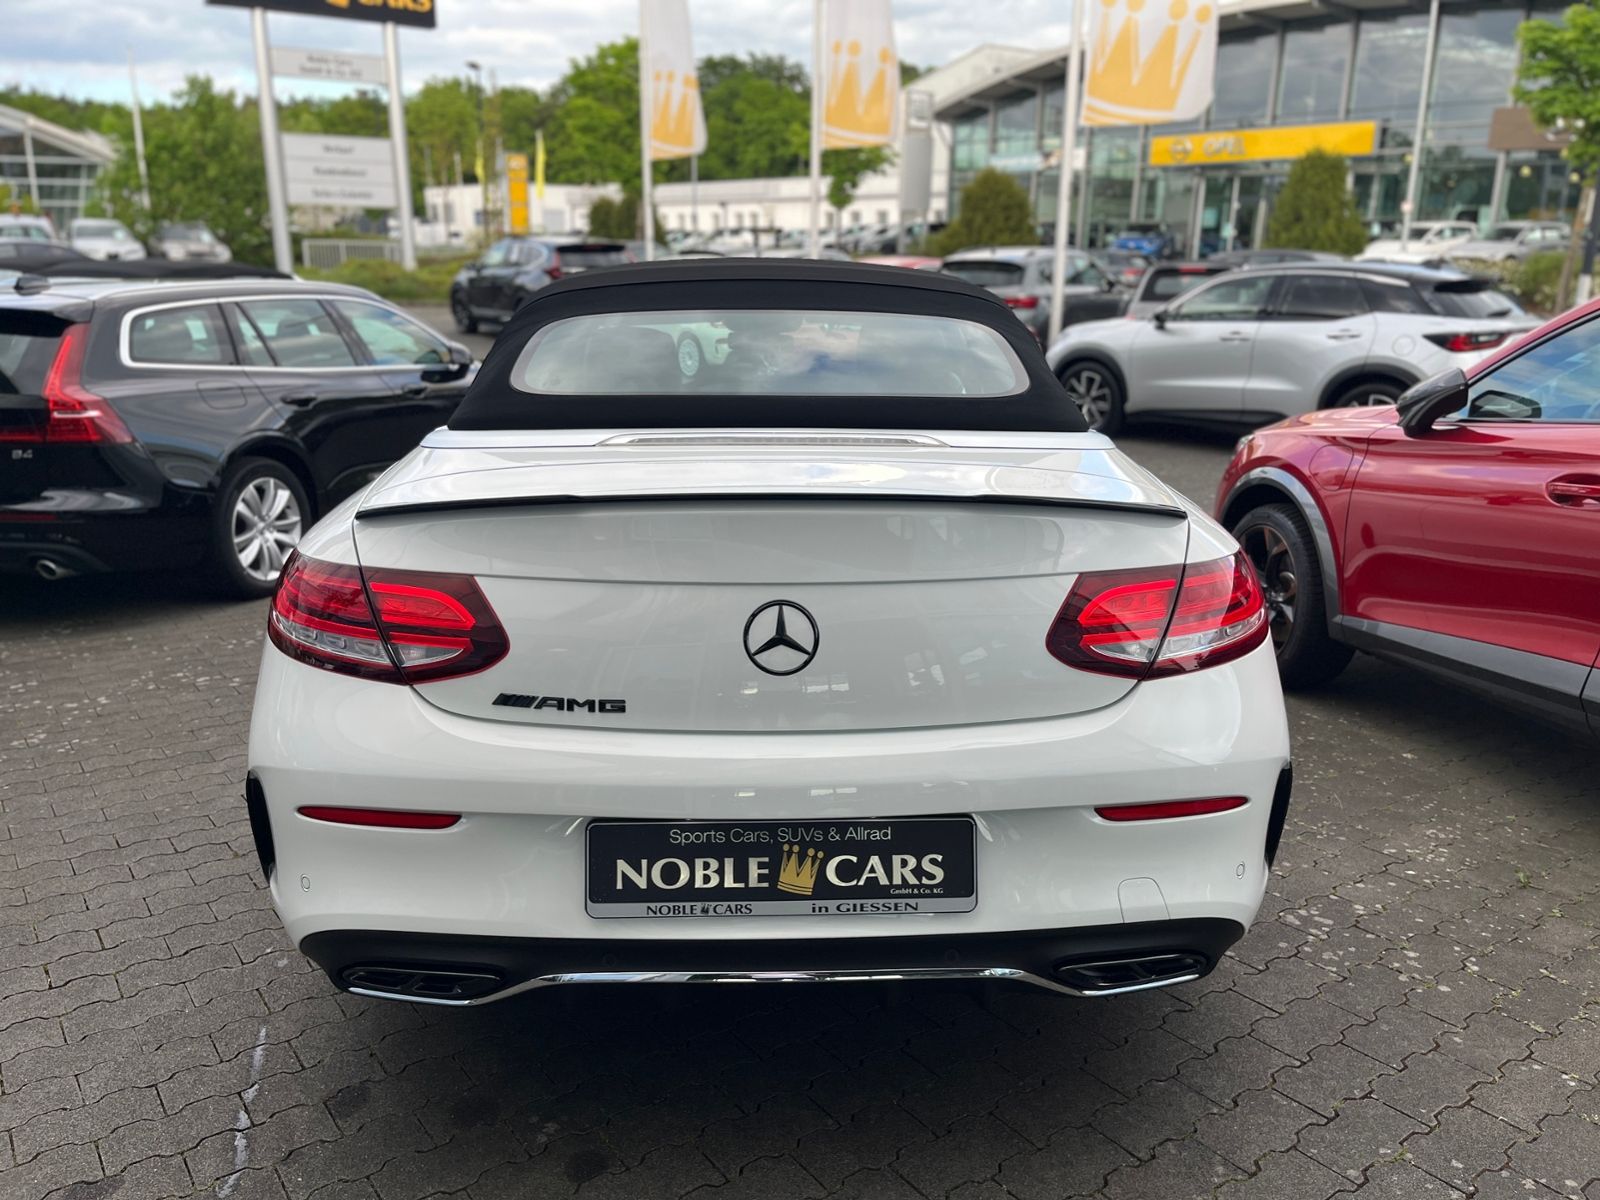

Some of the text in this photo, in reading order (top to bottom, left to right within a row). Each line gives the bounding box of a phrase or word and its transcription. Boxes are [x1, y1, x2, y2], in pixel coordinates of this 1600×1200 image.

[1203, 135, 1245, 157] OPEL
[533, 696, 626, 713] AMG
[669, 826, 892, 846] Sports Cars, SUVs & Allrad
[616, 853, 945, 890] NOBLE CARS
[646, 903, 753, 916] NOBLE CARS
[811, 902, 919, 914] in GIESSEN
